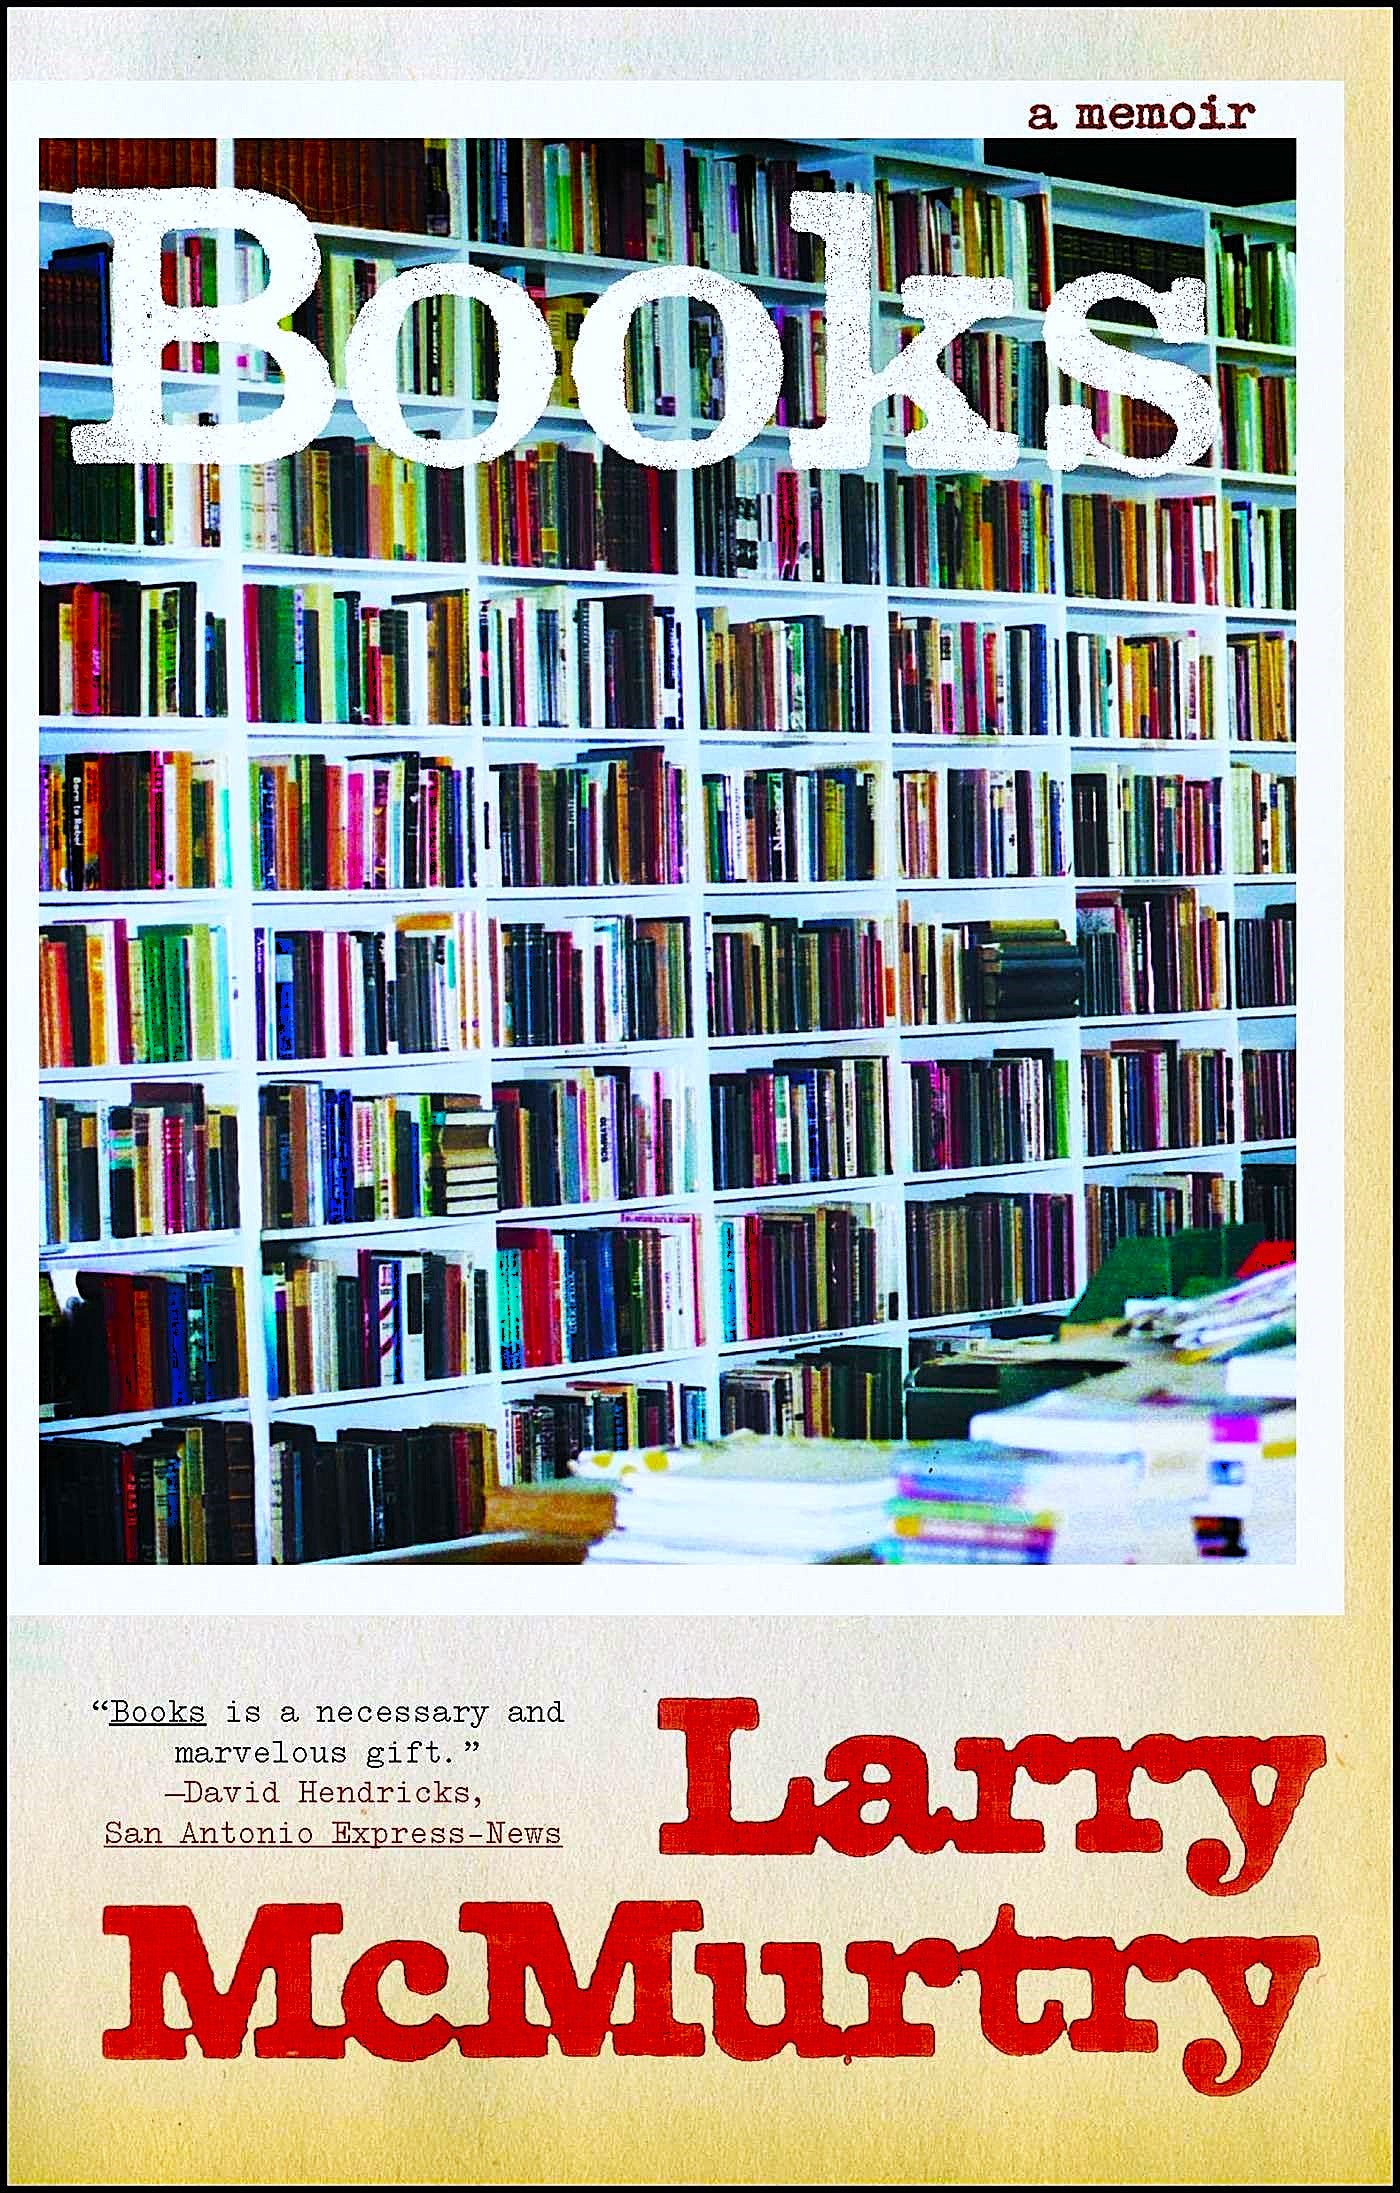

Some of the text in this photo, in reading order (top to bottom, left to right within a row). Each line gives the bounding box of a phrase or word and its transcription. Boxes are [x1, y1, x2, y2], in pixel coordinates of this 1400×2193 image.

[1029, 94, 1257, 131] a memoir
[71, 186, 1219, 478] Books
[227, 1700, 261, 1723] is
[280, 1705, 300, 1723] a
[315, 1705, 490, 1729] necessary
[507, 1700, 565, 1723] and
[174, 1740, 480, 1768] marvelous gift.”
[298, 1780, 481, 1808] Hendricks,
[657, 1697, 1327, 1897] Larry
[104, 1820, 562, 1848] San Antonio Express-News
[102, 1899, 1320, 2097] McMurtry
